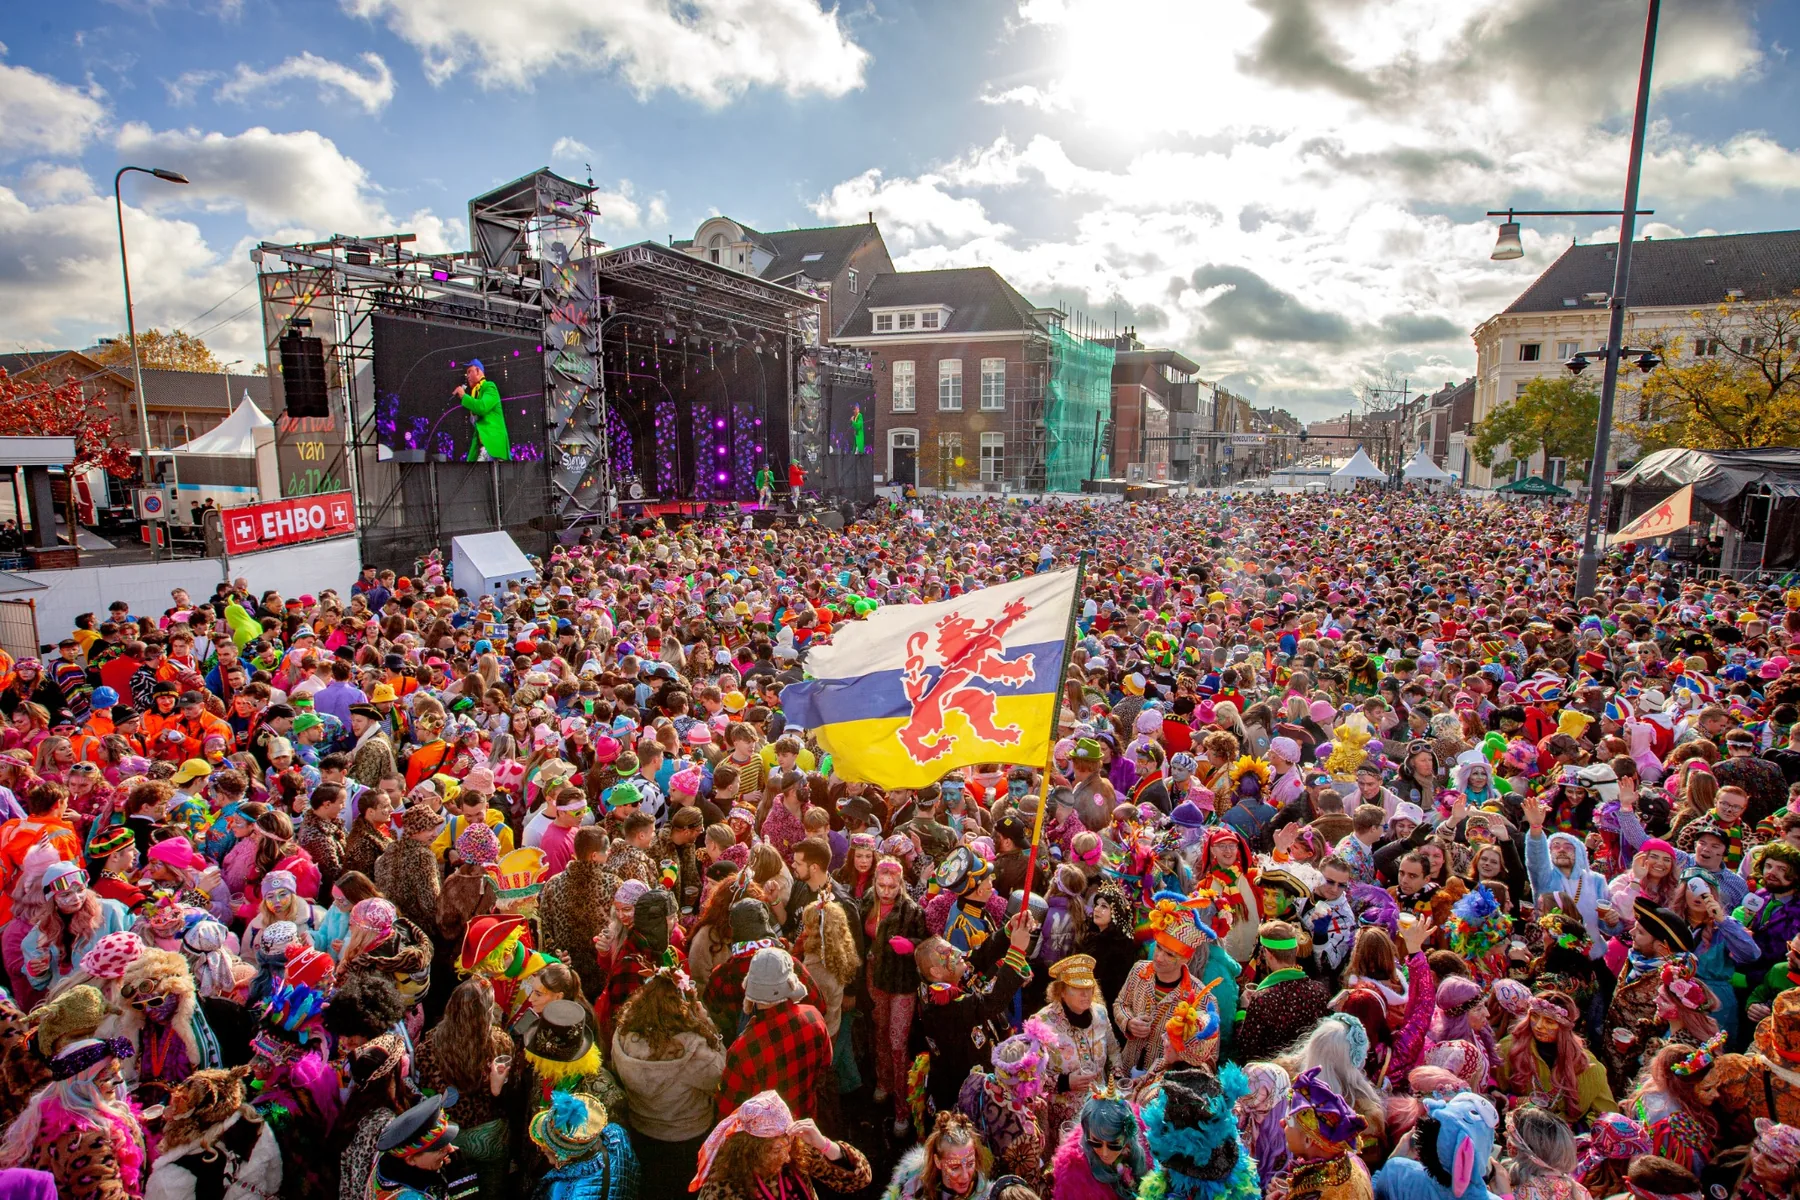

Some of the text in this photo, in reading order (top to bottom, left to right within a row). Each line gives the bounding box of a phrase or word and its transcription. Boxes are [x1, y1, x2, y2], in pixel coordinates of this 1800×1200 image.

[561, 330, 580, 347] van
[296, 441, 325, 461] van
[261, 504, 326, 540] EHBO
